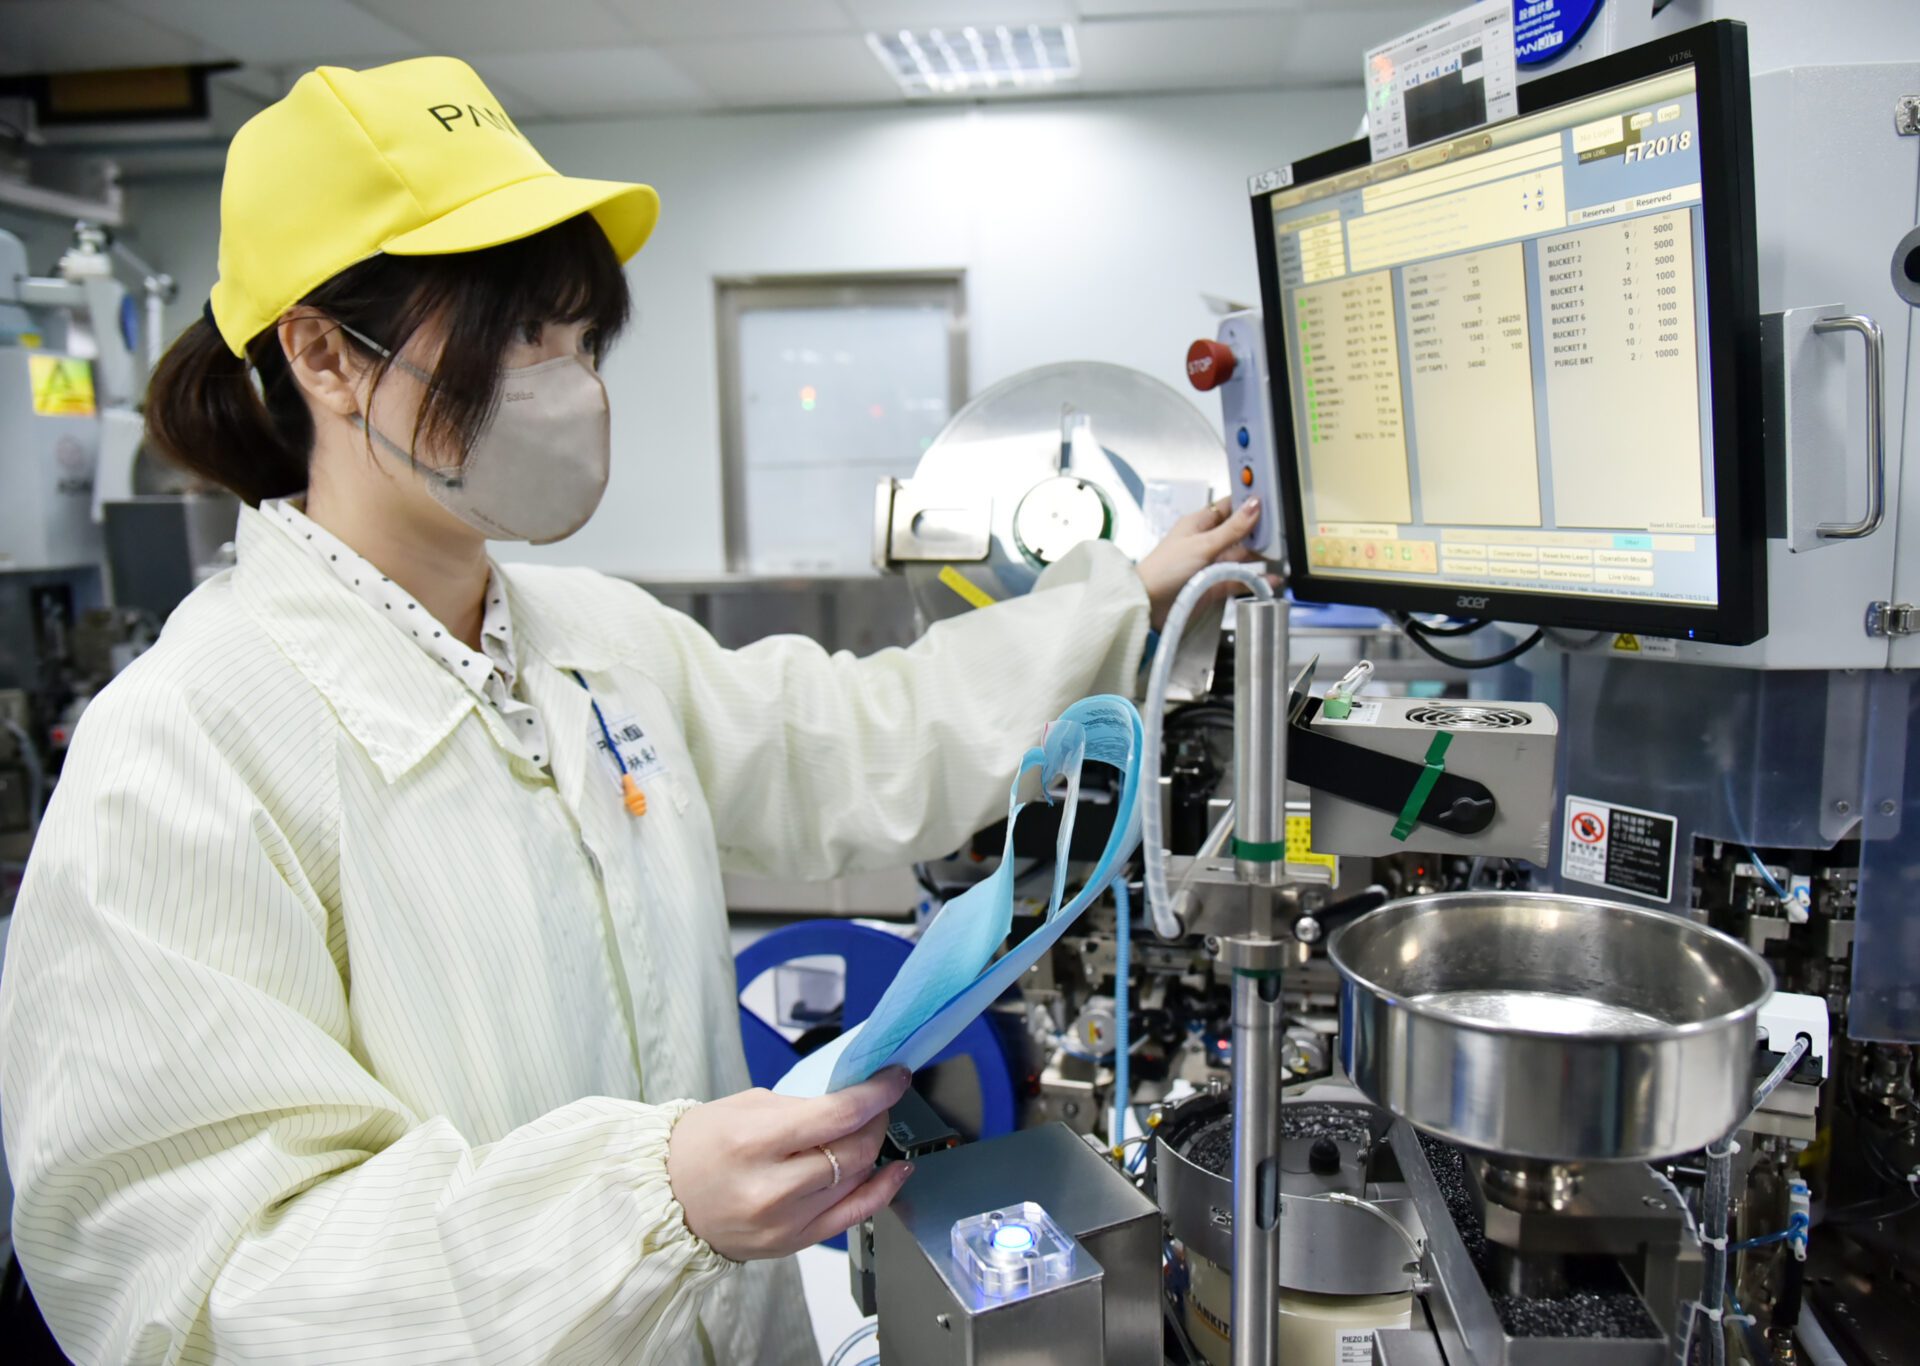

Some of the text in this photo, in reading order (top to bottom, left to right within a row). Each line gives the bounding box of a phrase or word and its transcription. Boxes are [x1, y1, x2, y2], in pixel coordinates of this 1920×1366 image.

[1668, 49, 1694, 64] V176L
[1624, 130, 1691, 165] FT2018
[1636, 193, 1671, 207] Reserved
[1583, 206, 1615, 218] Reserved
[1547, 242, 1574, 253] BUCKET
[1653, 223, 1673, 234] 5000
[1548, 257, 1575, 268] BUCKET
[1654, 239, 1674, 250] 5000
[1549, 271, 1576, 282] BUCKET
[1655, 255, 1674, 265] 5000
[1550, 286, 1577, 297] BUCKET
[1622, 278, 1632, 286] 35
[1656, 271, 1675, 281] 1000
[1551, 301, 1578, 310] BUCKET
[1623, 293, 1633, 301] 14
[1657, 286, 1676, 296] 1000
[1552, 316, 1579, 325] BUCKET
[1658, 302, 1677, 312] 1000
[1553, 330, 1580, 339] BUCKET
[1658, 317, 1677, 327] 1000
[1554, 344, 1581, 353] BUCKET
[1626, 338, 1635, 346] 10
[1658, 333, 1678, 342] 4000
[1188, 356, 1212, 375] STOP
[1555, 358, 1577, 367] PURGE
[1631, 353, 1635, 361] 2
[1655, 348, 1679, 358] 10000
[1456, 596, 1490, 609] acer
